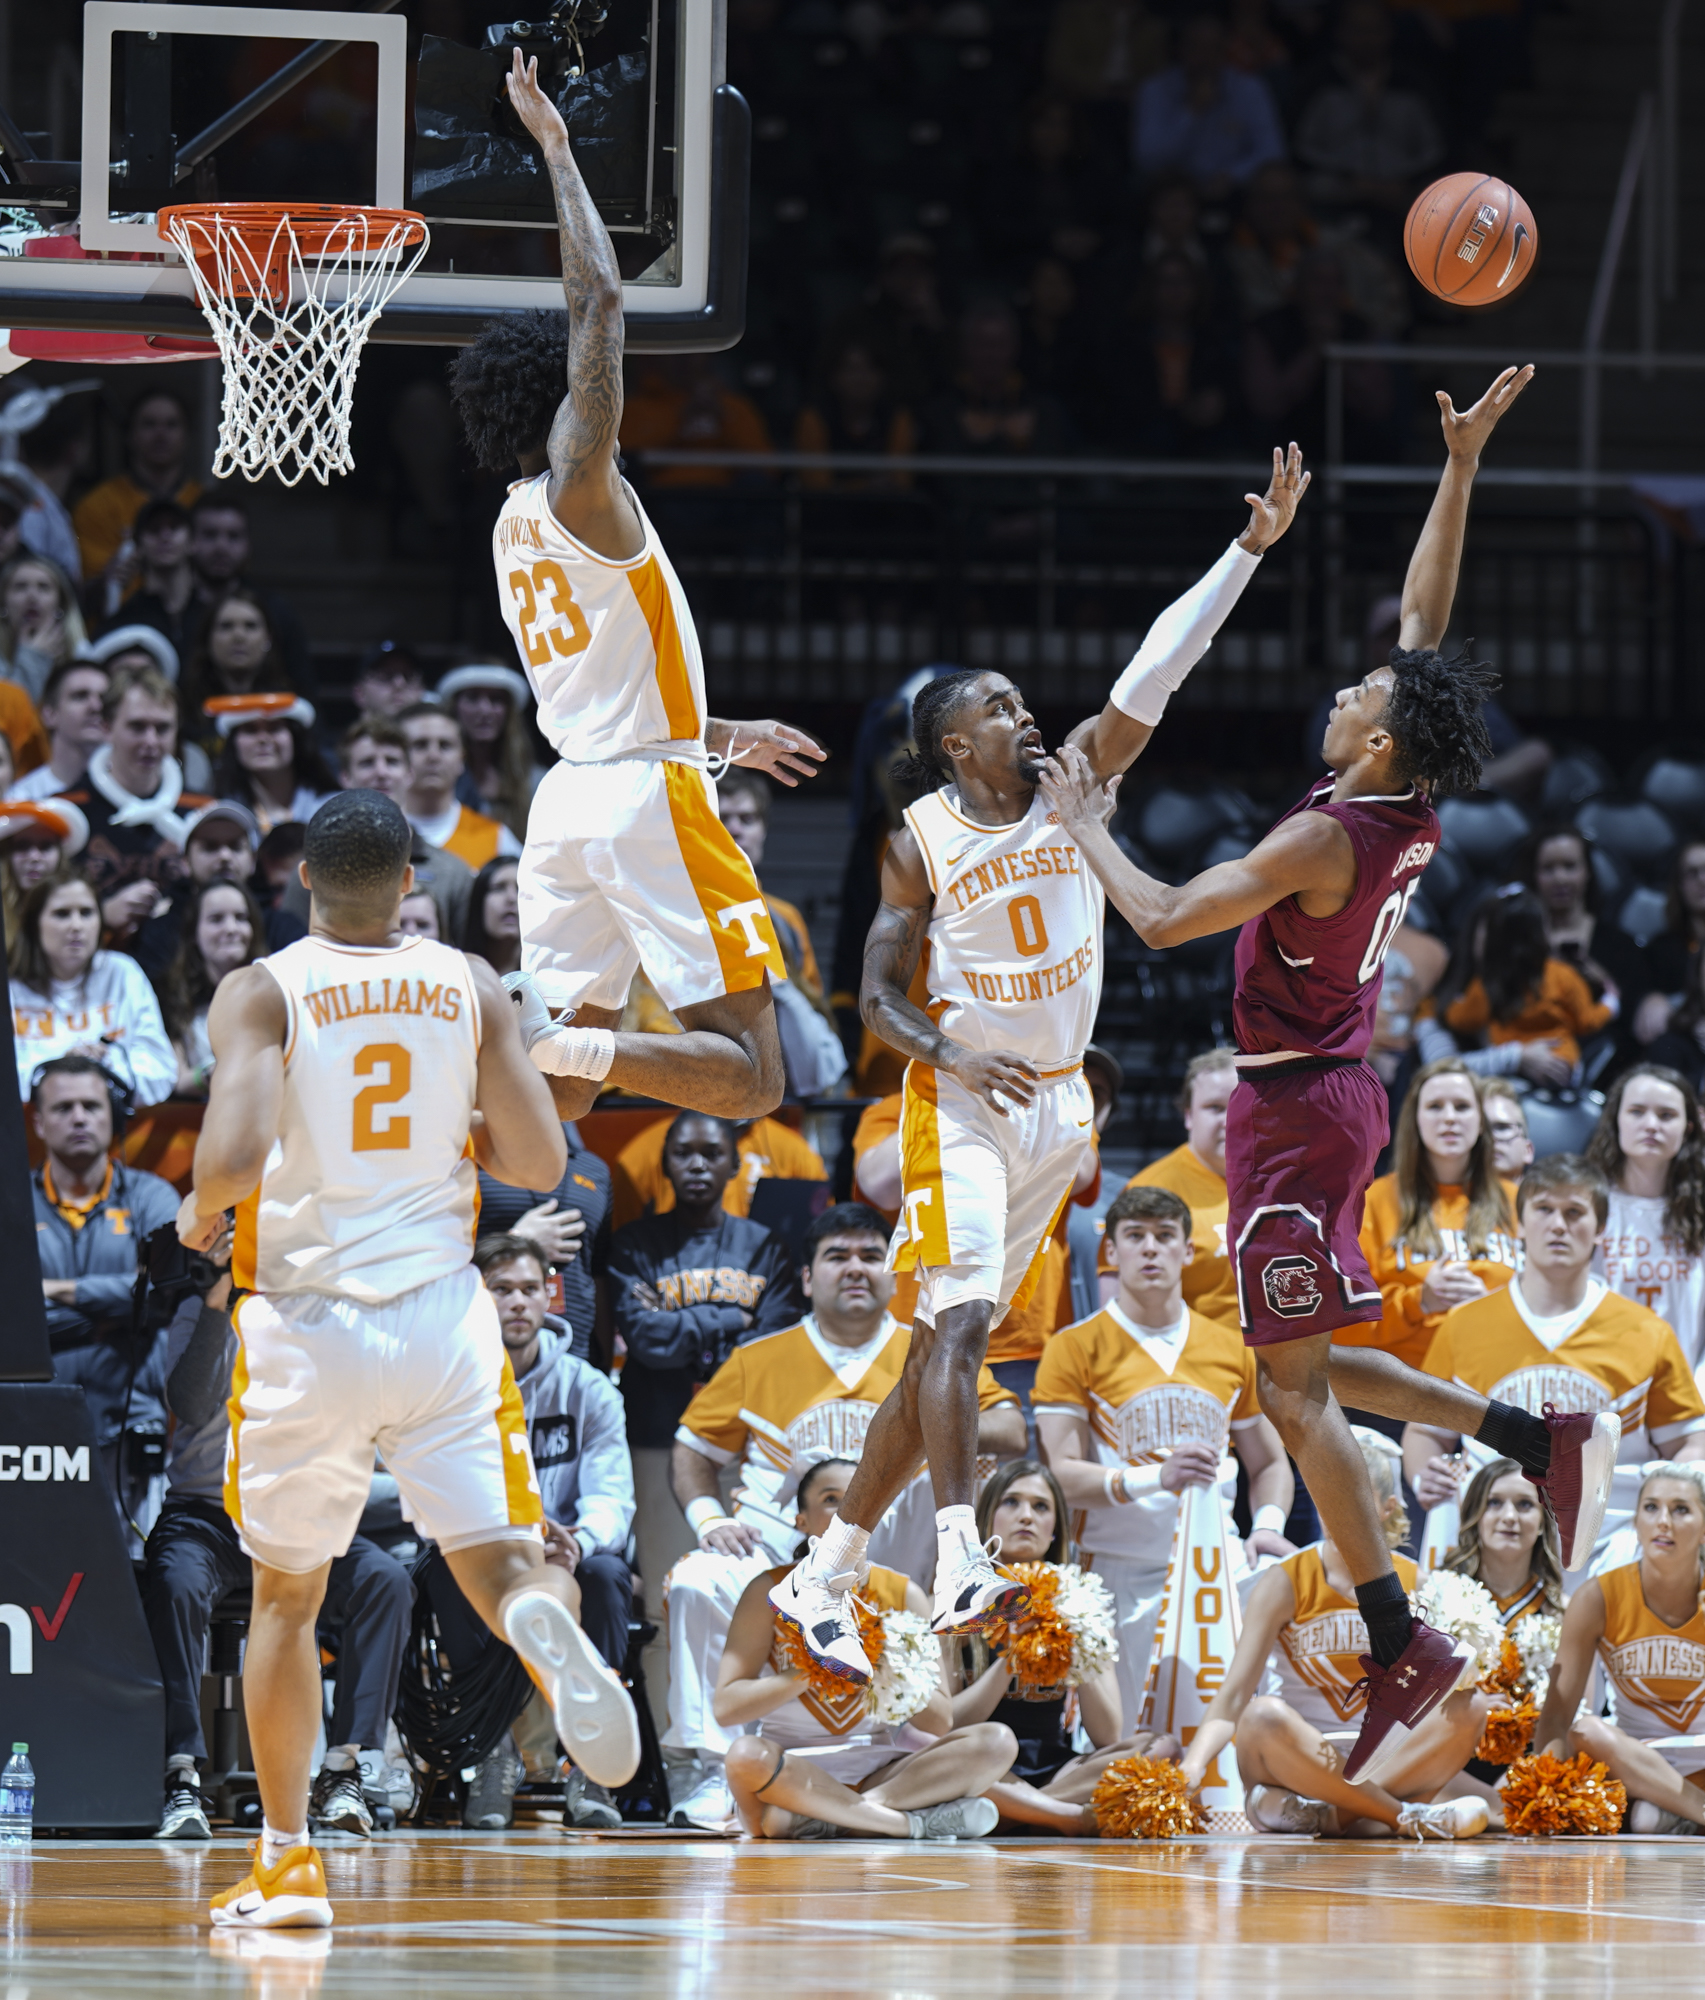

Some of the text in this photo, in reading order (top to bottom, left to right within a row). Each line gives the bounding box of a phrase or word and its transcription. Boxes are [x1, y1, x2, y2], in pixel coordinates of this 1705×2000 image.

[1457, 204, 1499, 263] ELITE
[509, 559, 592, 667] 23
[947, 847, 1080, 912] TENNESSEE
[716, 898, 770, 957] T
[1007, 895, 1049, 957] 0
[961, 935, 1093, 1003] VOLUNTEERS
[303, 978, 462, 1029] WILLIAMS
[352, 1043, 411, 1152] 2
[104, 1208, 131, 1235] T
[1602, 1236, 1650, 1257] EED
[1606, 1260, 1690, 1286] FLOOR
[1636, 1286, 1662, 1309] T
[1192, 1546, 1226, 1704] VOLS
